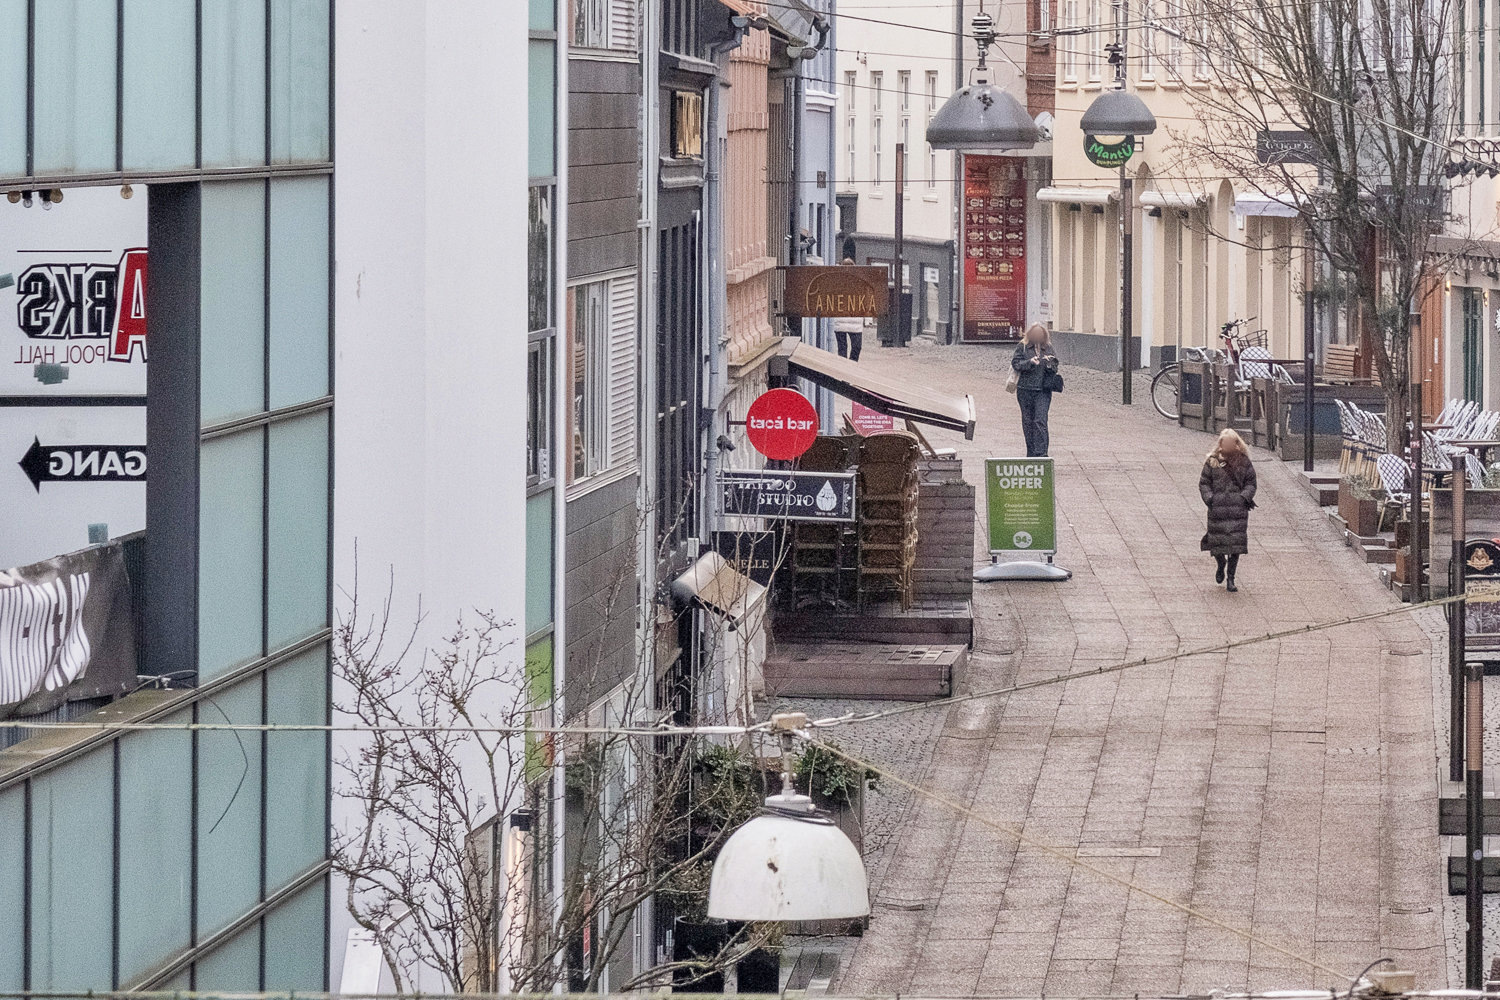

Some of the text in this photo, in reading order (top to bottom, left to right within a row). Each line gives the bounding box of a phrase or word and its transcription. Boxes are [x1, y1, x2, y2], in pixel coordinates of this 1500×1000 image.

[787, 417, 814, 430] bar
[996, 464, 1045, 477] LUNCH
[999, 477, 1043, 489] OFFER
[758, 493, 815, 507] STUDIO
